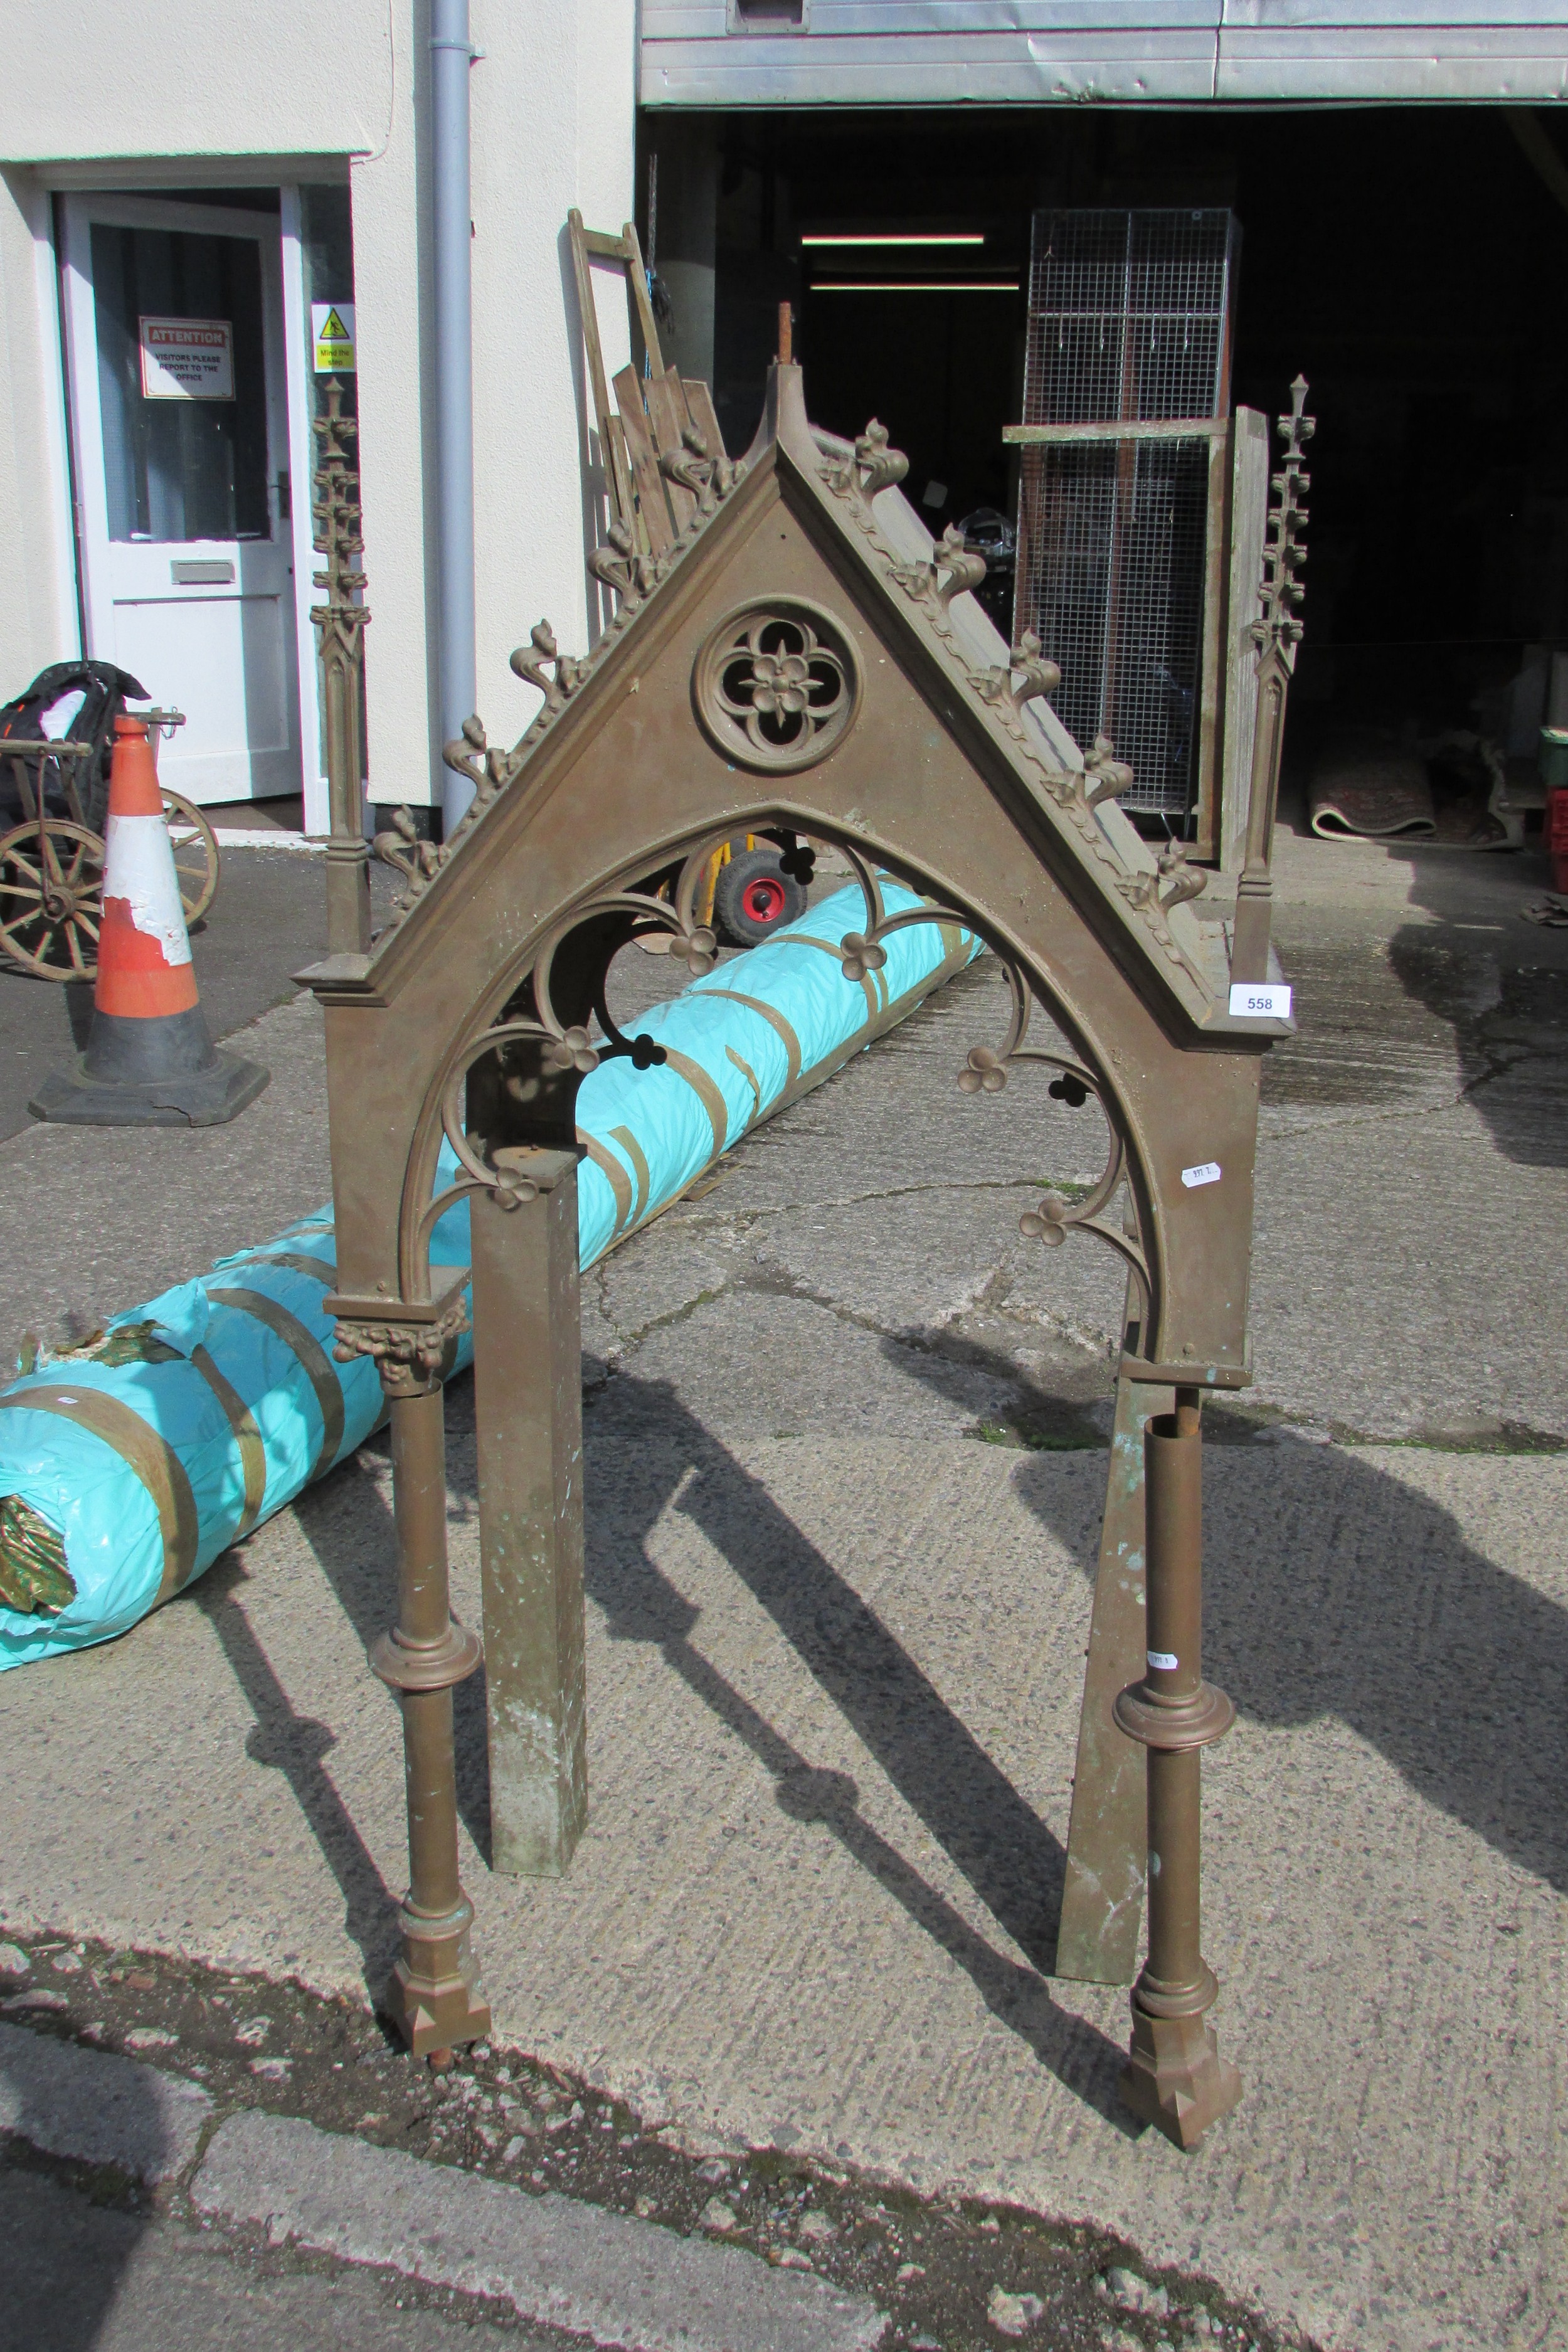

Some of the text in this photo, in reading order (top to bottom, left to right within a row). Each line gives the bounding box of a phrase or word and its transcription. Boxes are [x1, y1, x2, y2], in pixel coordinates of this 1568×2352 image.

[152, 329, 222, 343] ATTENTION
[156, 354, 221, 363] VISITORS PLEASE
[159, 363, 189, 371] REPORT
[1248, 998, 1273, 1010] 558
